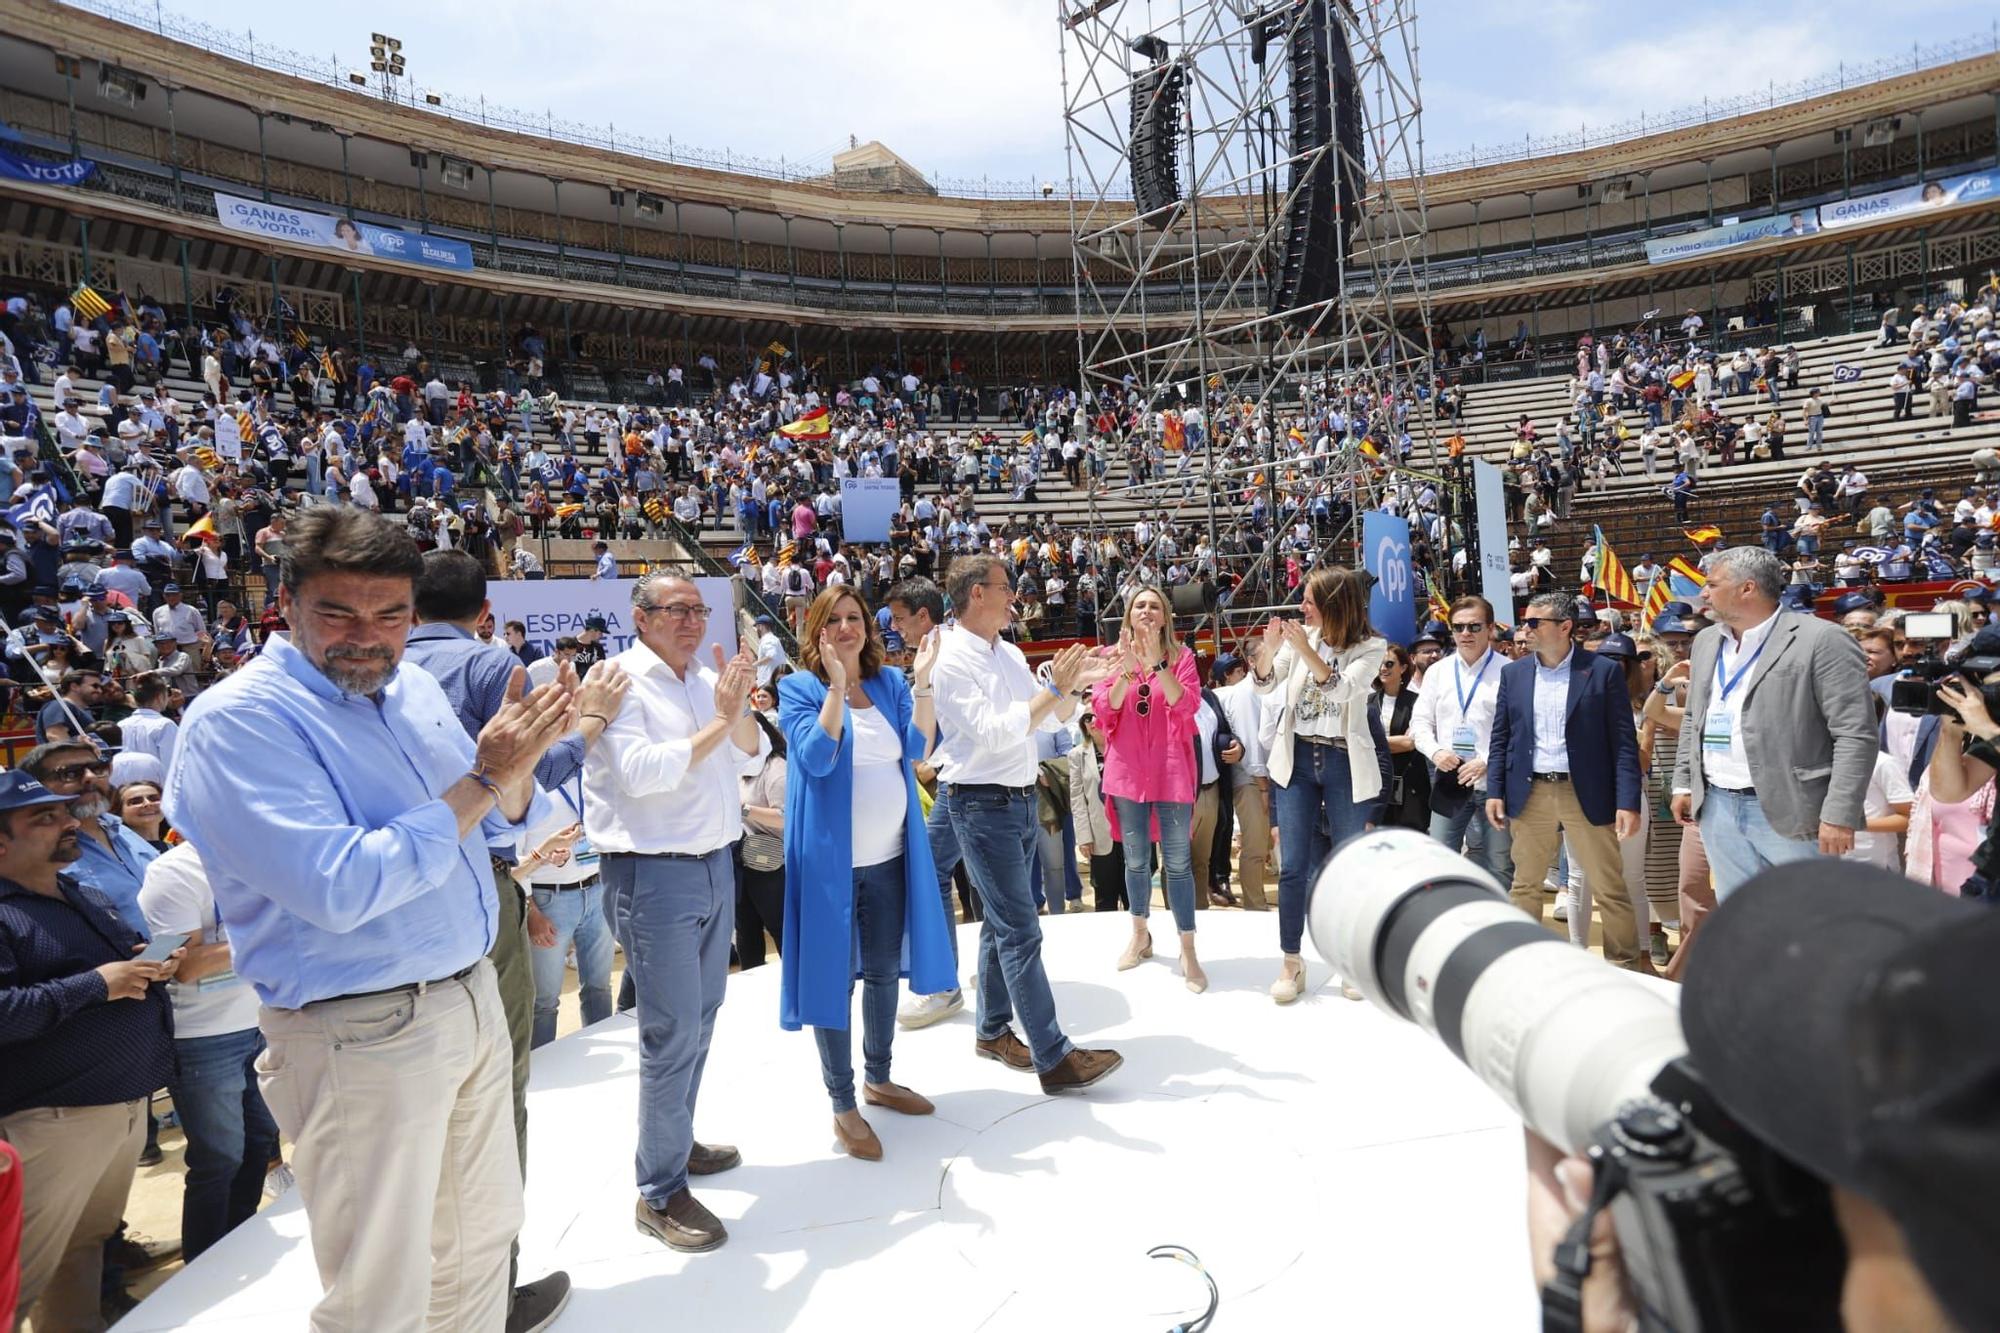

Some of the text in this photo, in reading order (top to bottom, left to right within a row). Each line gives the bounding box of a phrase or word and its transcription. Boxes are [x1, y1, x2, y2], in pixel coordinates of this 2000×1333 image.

[22, 162, 85, 180] VOTA
[256, 221, 316, 239] VOTAR!
[1661, 243, 1702, 255] CAMBIO
